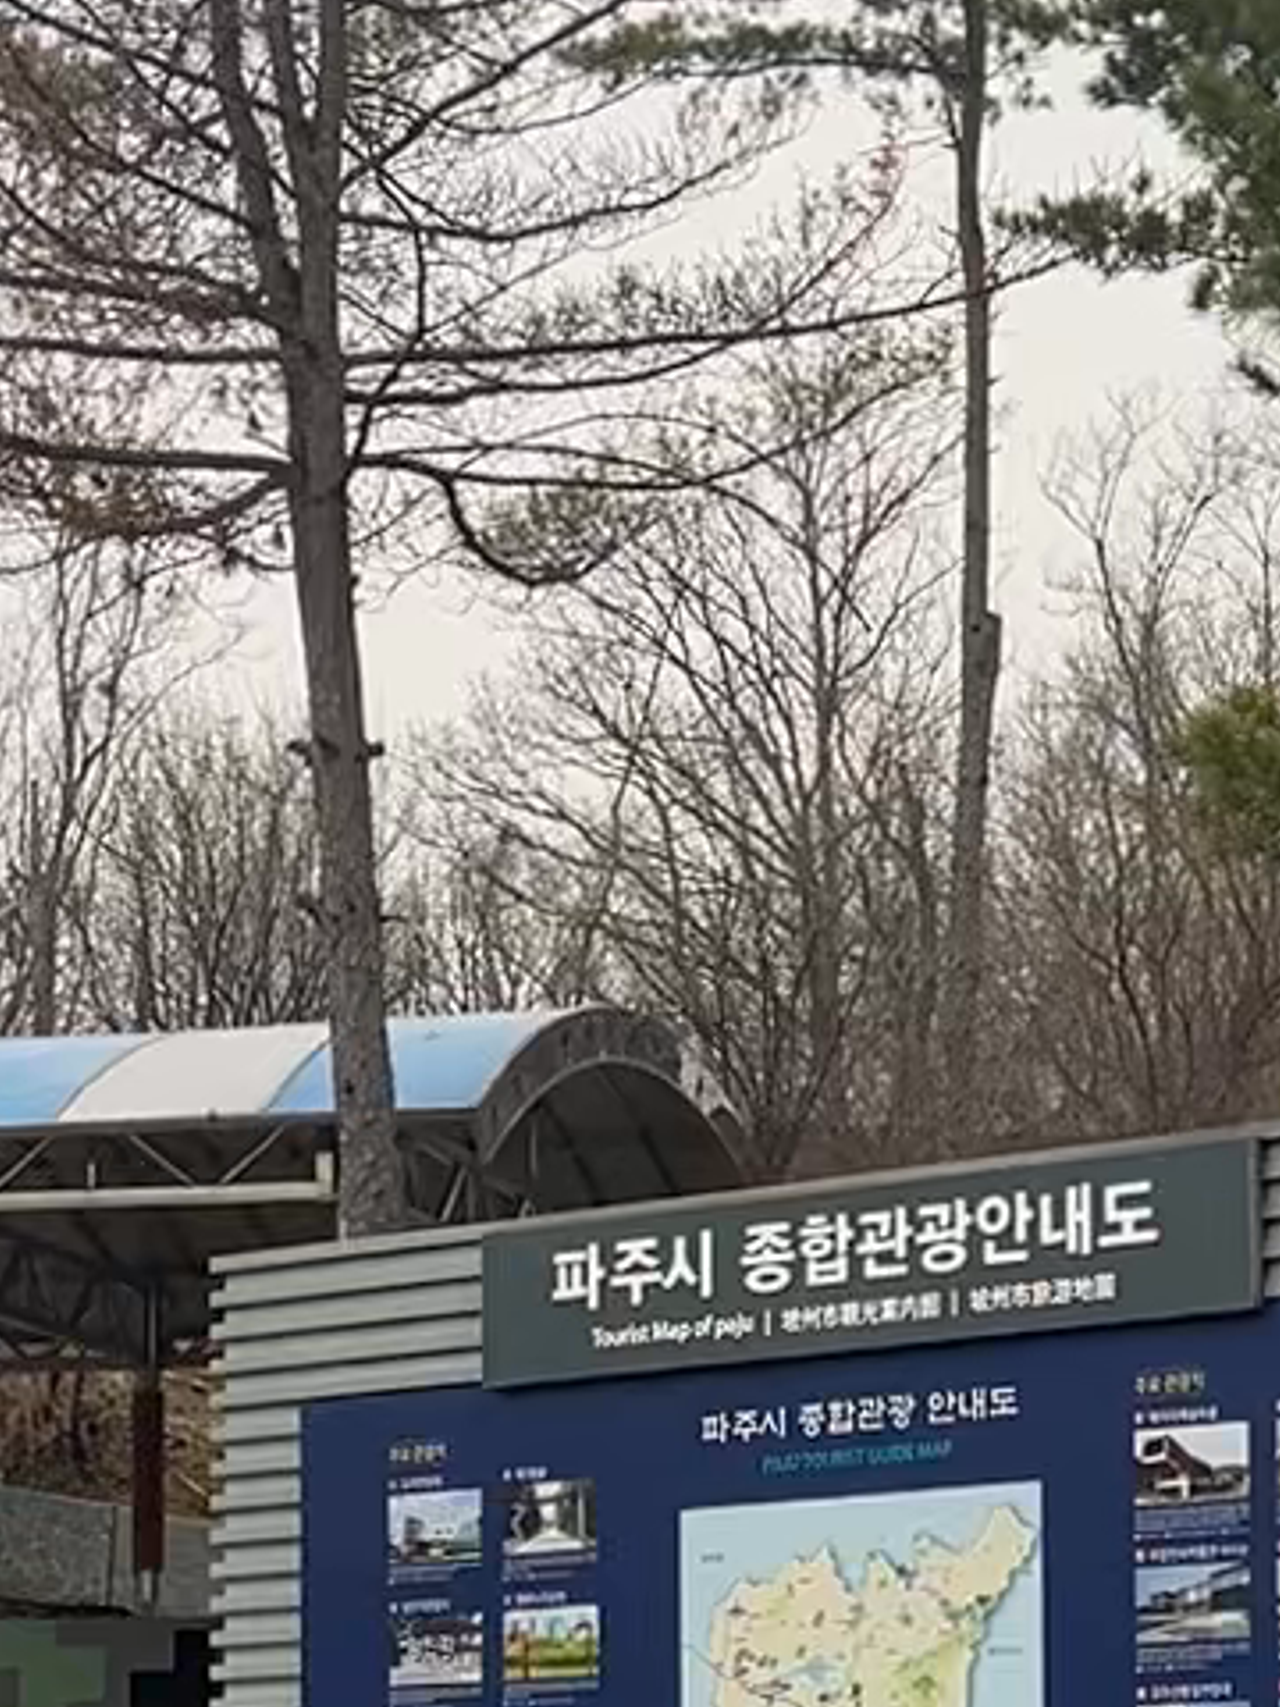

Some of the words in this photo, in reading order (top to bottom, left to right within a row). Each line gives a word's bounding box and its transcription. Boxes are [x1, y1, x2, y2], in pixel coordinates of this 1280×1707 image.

[550, 1227, 715, 1311] 파주시
[738, 1178, 1161, 1294] 종합관광안내도
[701, 1406, 787, 1444] 파주시
[798, 1393, 917, 1439] 종합관광
[927, 1386, 1020, 1425] 안내도
